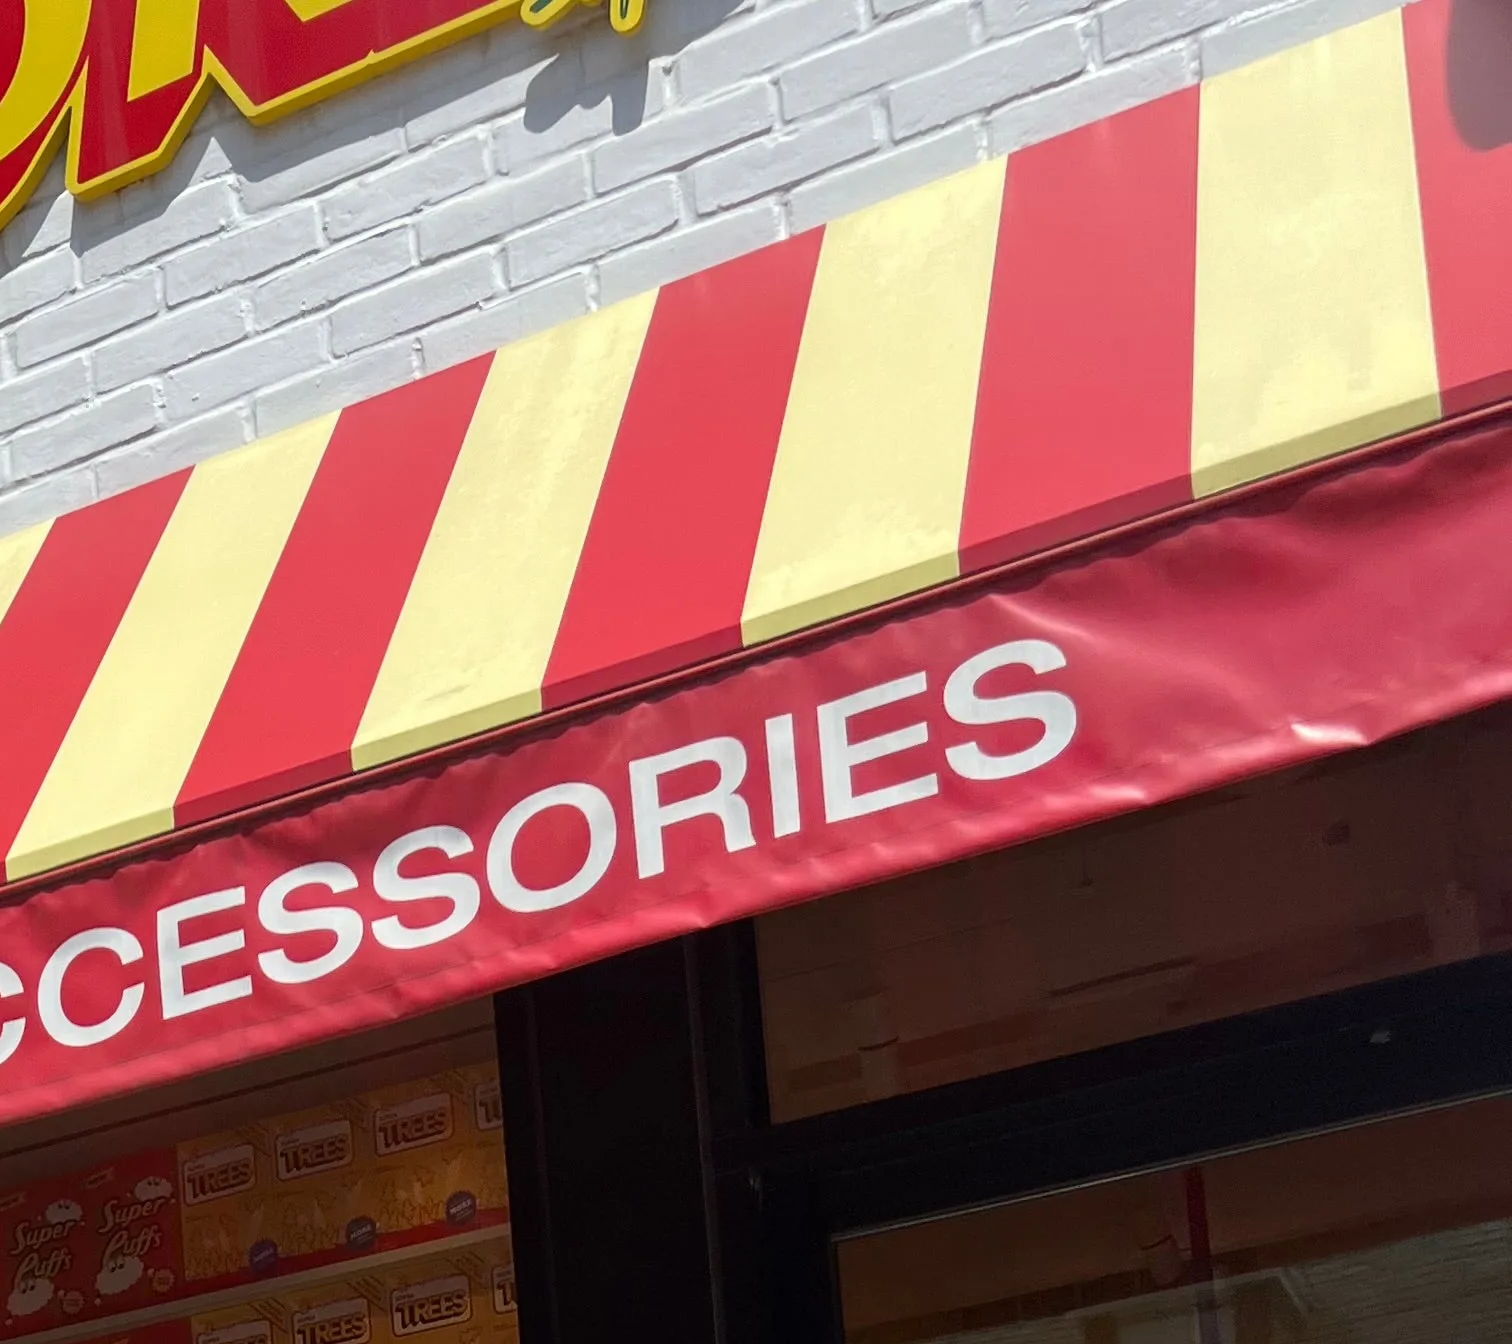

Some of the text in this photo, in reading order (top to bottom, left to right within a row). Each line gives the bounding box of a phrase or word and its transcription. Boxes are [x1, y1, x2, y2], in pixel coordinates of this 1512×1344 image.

[379, 1108, 448, 1147] TREES
[280, 1134, 350, 1173] TREES
[188, 1159, 252, 1203] TREES
[99, 1198, 164, 1232] Super
[103, 1224, 161, 1266] Puffs
[395, 1286, 469, 1329] TREES
